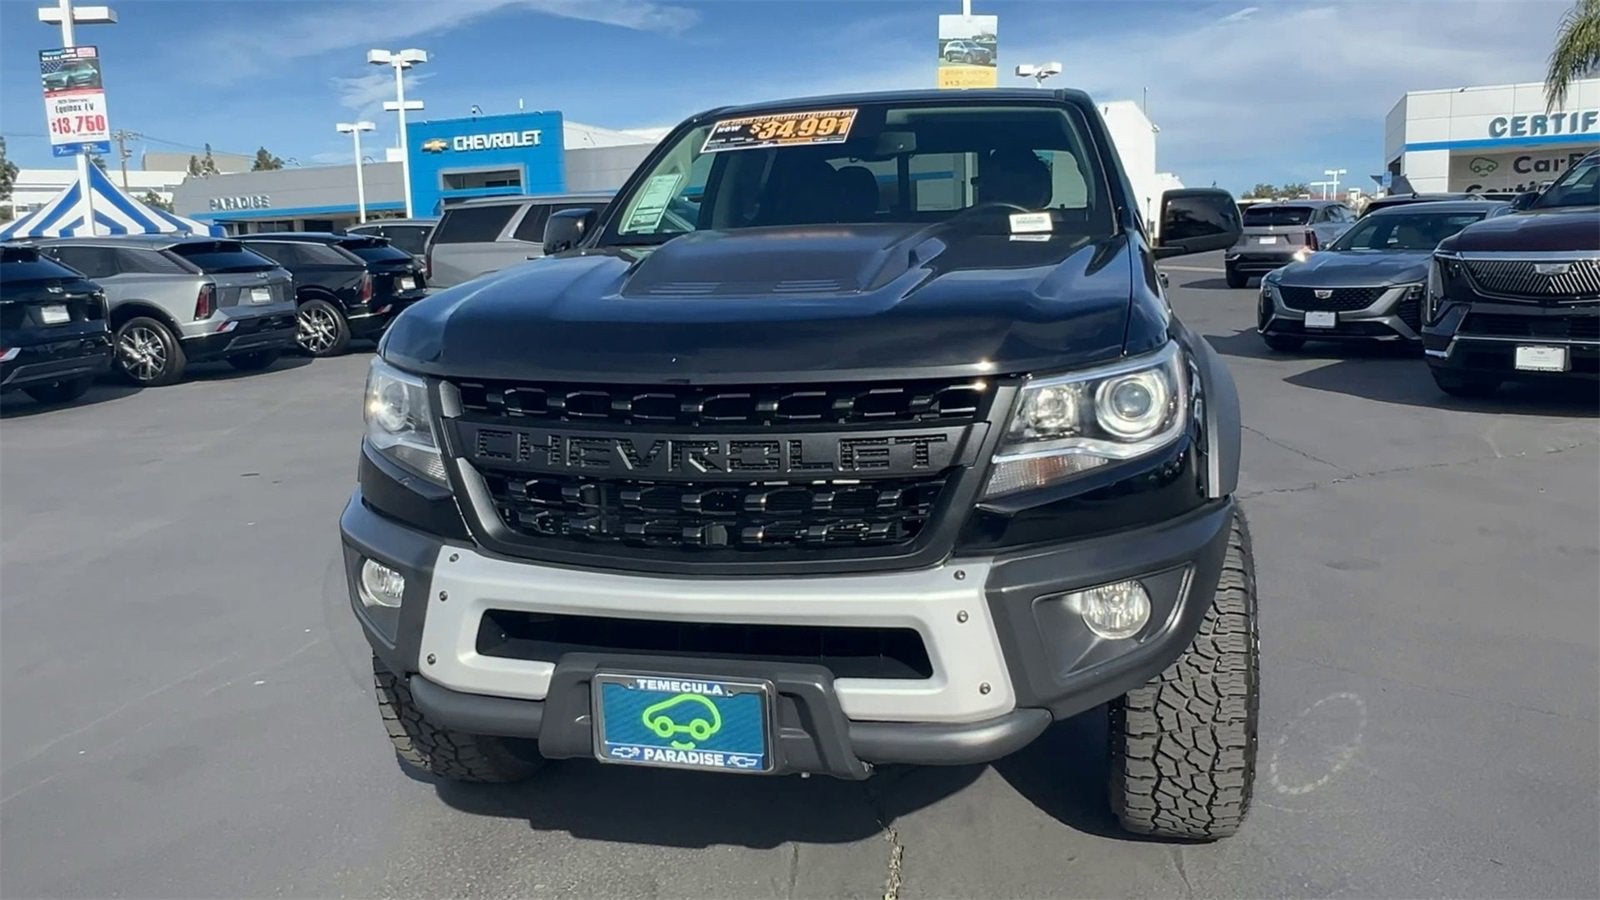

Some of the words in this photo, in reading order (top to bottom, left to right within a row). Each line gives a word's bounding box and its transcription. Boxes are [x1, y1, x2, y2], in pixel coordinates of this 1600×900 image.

[1488, 111, 1599, 138] CERTIF
[453, 129, 542, 151] CHEVROLET
[209, 194, 271, 211] PARADISE
[474, 428, 948, 473] CHEVROLET
[636, 679, 723, 696] TEMECULA
[643, 748, 725, 767] PARADISE
